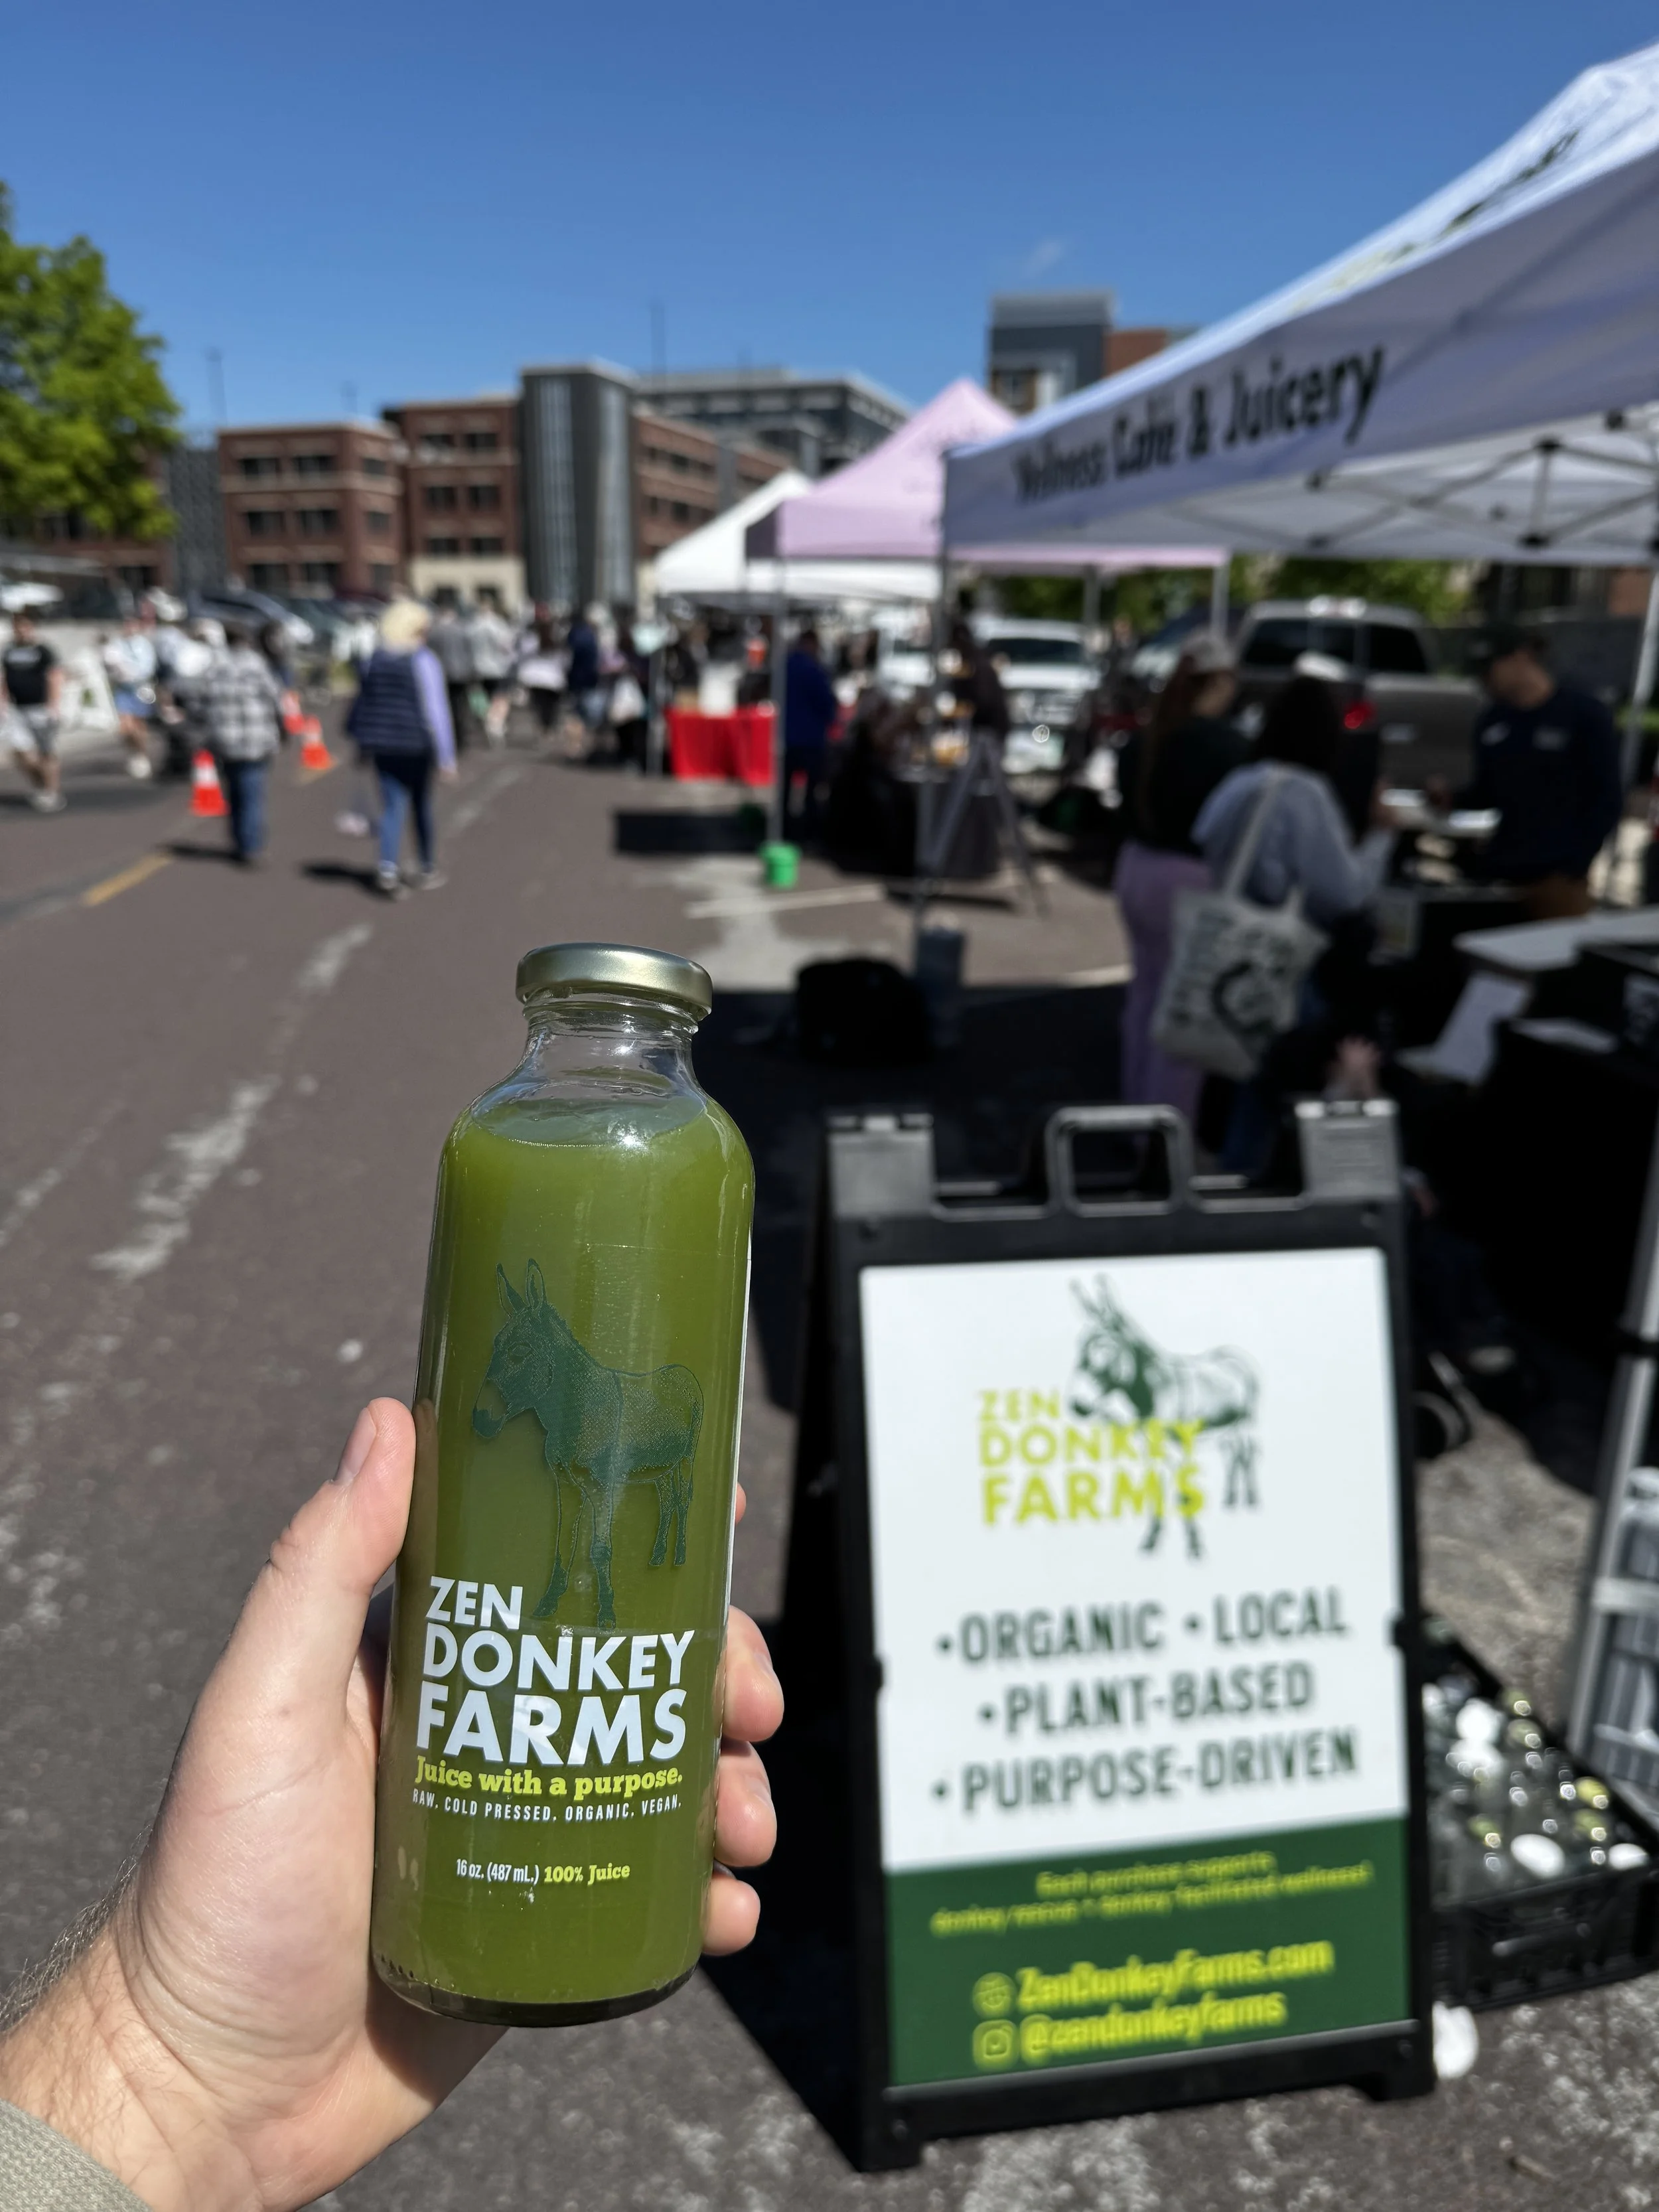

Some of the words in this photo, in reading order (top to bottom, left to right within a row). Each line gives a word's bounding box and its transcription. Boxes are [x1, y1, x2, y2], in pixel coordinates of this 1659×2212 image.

[1225, 344, 1385, 447] Juicery
[977, 1388, 1060, 1424] ZEN
[979, 1419, 1205, 1469] DONKEY
[981, 1465, 1208, 1524] FARMS
[425, 1576, 523, 1631] ZEN
[960, 1601, 1166, 1664] ORGANIC
[1214, 1587, 1348, 1645] LOCAL
[423, 1622, 695, 1691] DONKEY
[415, 1680, 687, 1766] FARMS
[1005, 1660, 1315, 1735] PLANT-BASED
[413, 1788, 439, 1809] RAW.
[445, 1796, 477, 1816] COLD
[484, 1803, 557, 1822] PRESSED.
[565, 1803, 634, 1822] ORGANIC.
[641, 1794, 682, 1816] VEGAN.
[415, 1755, 472, 1789] Juice
[478, 1768, 542, 1795] with
[549, 1776, 568, 1797] a
[574, 1767, 683, 1801] purpose.
[963, 1728, 1359, 1814] PURPOSE-DRIVEN
[457, 1858, 468, 1878] 16
[469, 1864, 484, 1880] oz.
[486, 1862, 512, 1882] (487
[513, 1864, 540, 1885] mL.)
[544, 1866, 583, 1883] 100%
[587, 1863, 630, 1885] Juice
[1018, 1940, 1334, 2010] ZenDonkeyFarms.com
[1021, 1992, 1289, 2067] @zendonkeyfarms
